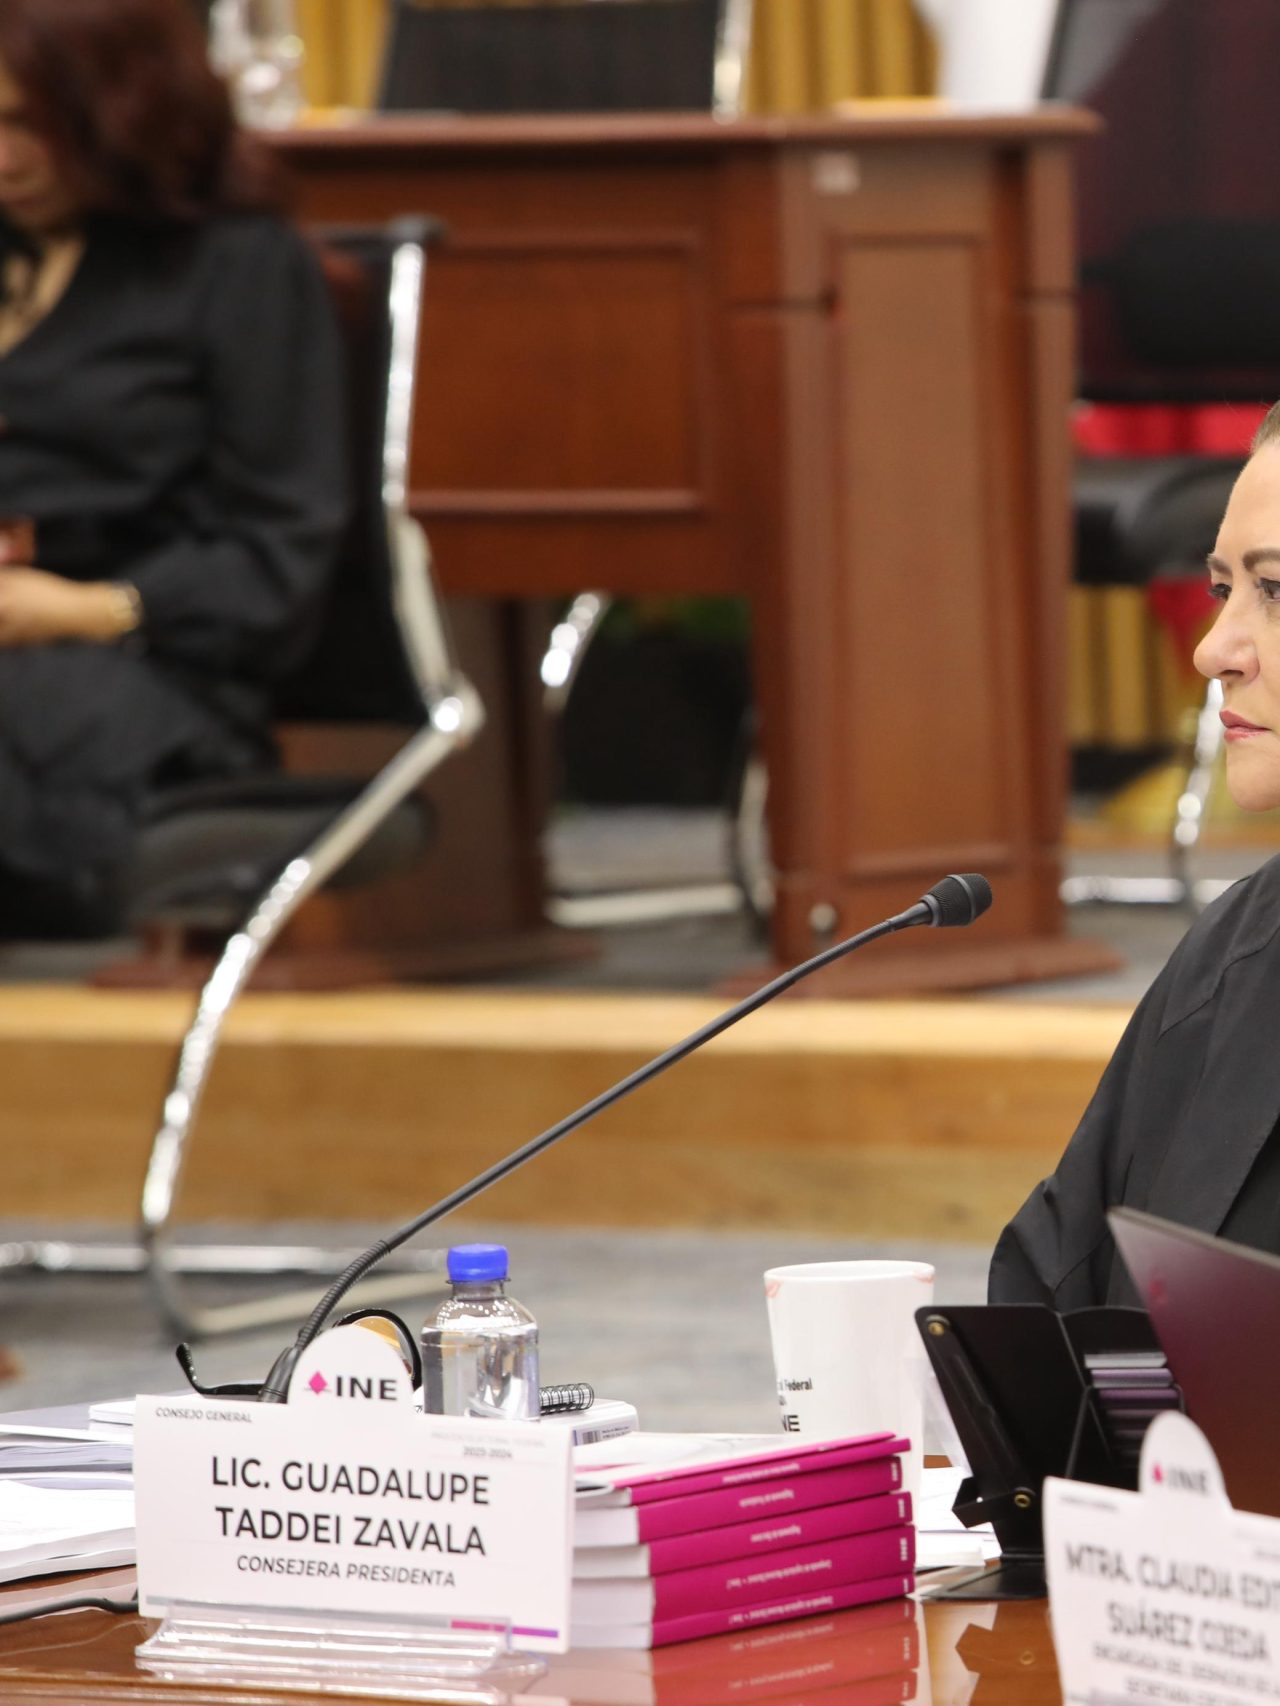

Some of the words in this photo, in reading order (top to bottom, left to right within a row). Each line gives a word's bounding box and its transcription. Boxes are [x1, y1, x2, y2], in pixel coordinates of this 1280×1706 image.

[335, 1375, 399, 1401] INE
[155, 1406, 204, 1421] CONSEJO
[206, 1409, 253, 1423] GENERAL
[211, 1455, 271, 1490] LIC.
[281, 1460, 490, 1505] GUADALUPE
[214, 1506, 342, 1545] TADDEI
[353, 1516, 487, 1557] ZAVALA
[236, 1554, 341, 1579] CONSEJERA
[346, 1563, 457, 1587] PRESIDENTA
